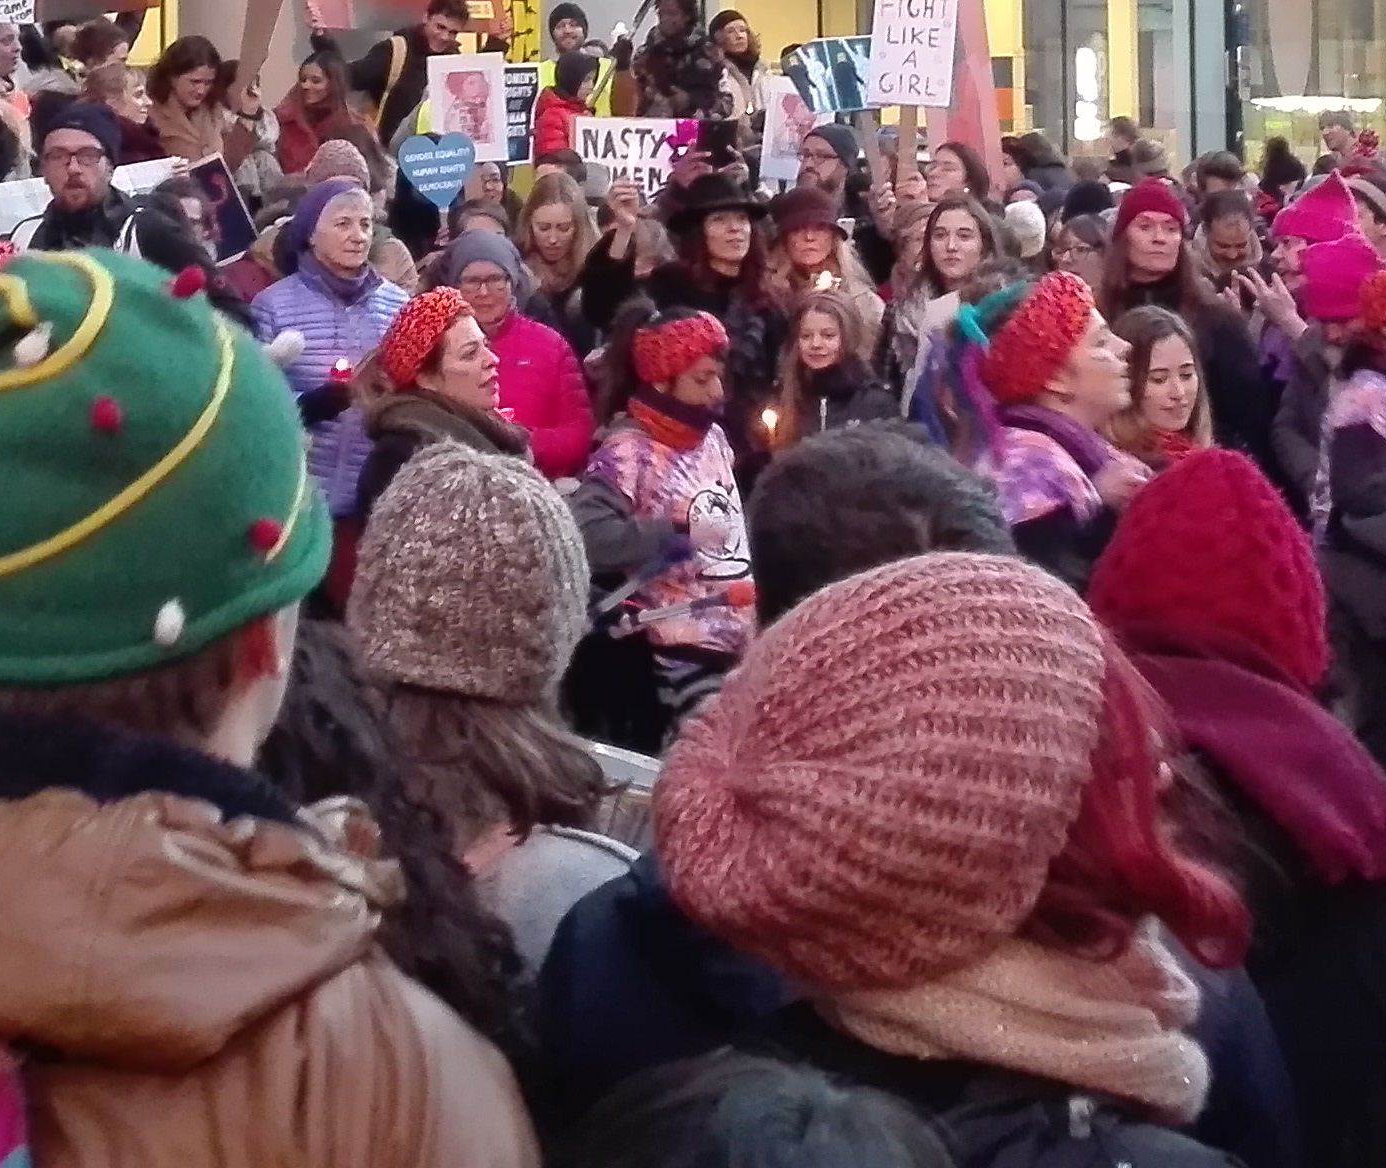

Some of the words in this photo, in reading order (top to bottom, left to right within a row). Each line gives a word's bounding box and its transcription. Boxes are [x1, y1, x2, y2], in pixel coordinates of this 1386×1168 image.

[886, 25, 940, 48] LIKE
[902, 50, 917, 68] A
[879, 73, 937, 97] GIRL
[582, 128, 671, 159] NASTY
